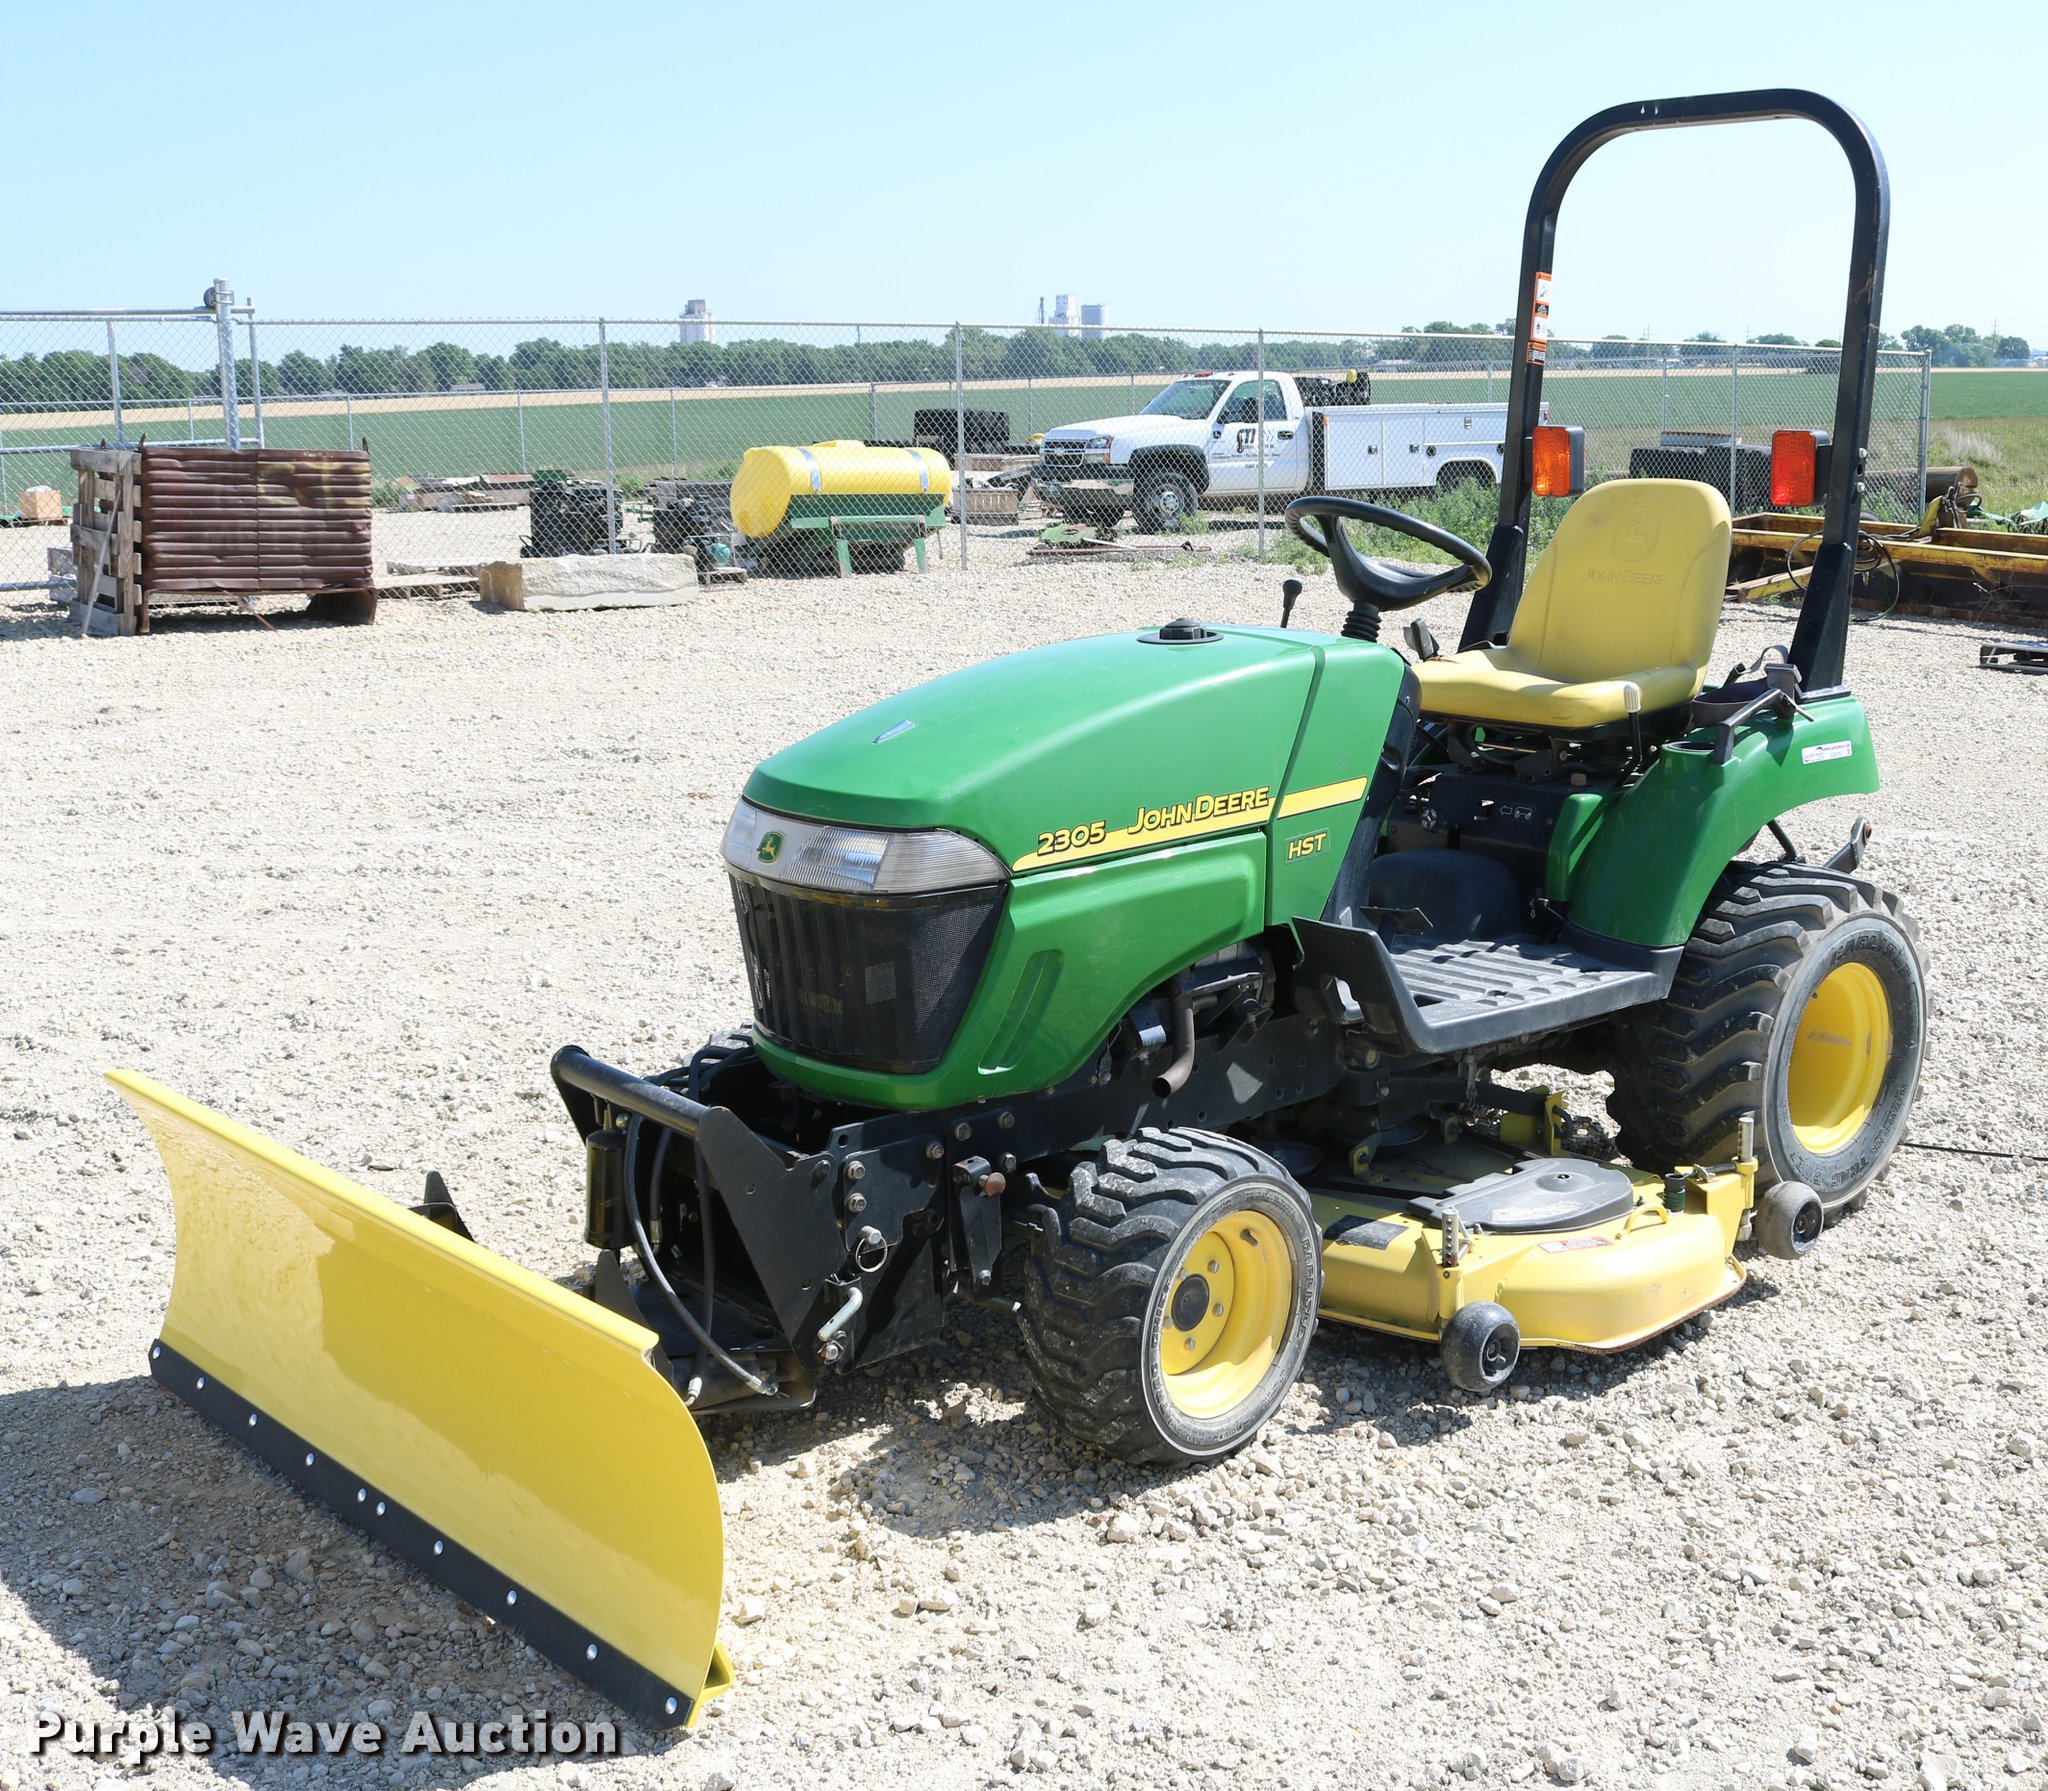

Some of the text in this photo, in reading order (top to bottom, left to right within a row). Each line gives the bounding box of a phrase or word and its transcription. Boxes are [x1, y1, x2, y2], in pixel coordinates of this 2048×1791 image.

[1581, 567, 1669, 586] JOHN DEERE
[1036, 786, 1270, 857] 2305 JOHN DEERE
[1287, 832, 1328, 861] HST
